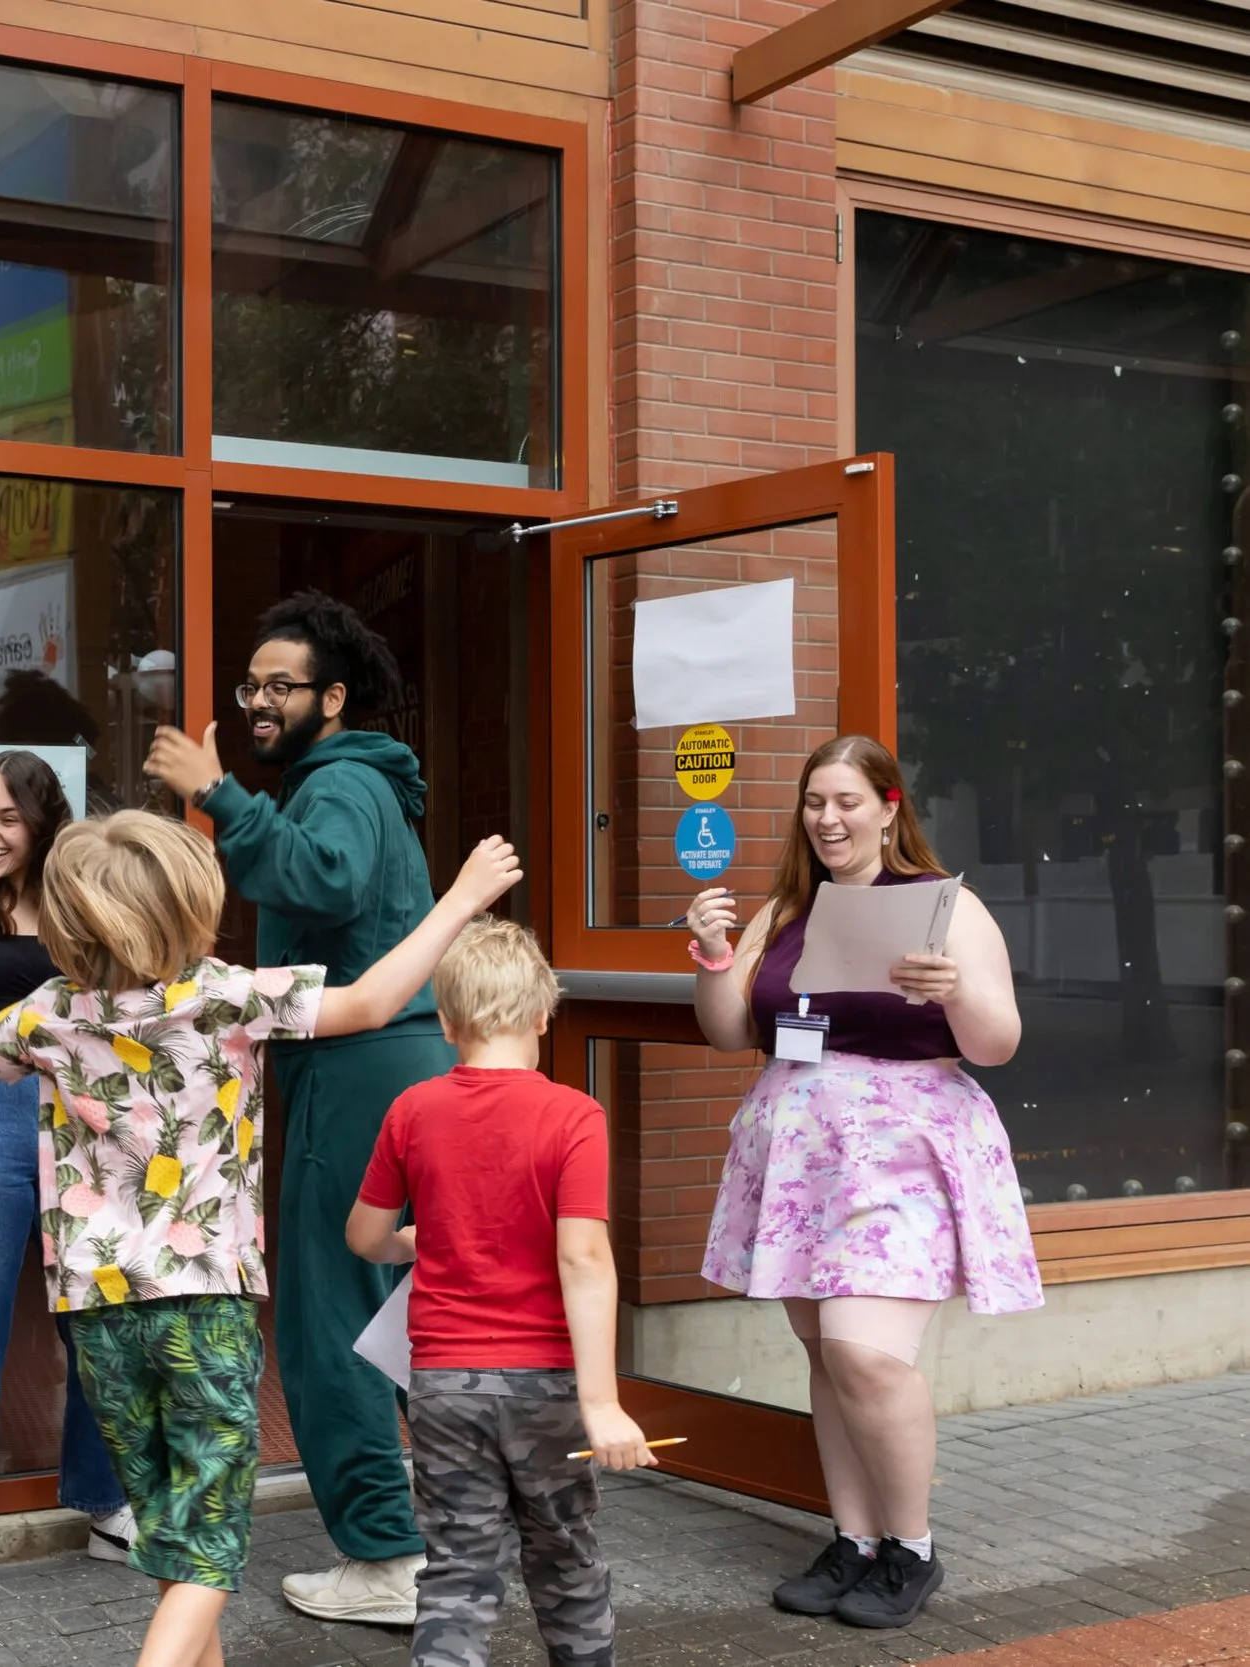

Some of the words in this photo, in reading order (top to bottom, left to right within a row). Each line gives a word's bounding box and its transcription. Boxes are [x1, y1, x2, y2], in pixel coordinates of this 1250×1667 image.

[680, 738, 730, 751] AUTOMATIC
[677, 753, 731, 769] CAUTION
[692, 773, 717, 784] DOOR
[680, 850, 707, 859] ACTIVATE
[707, 849, 730, 859] SWITCH
[688, 861, 696, 869] TO
[697, 860, 722, 869] OPERATE
